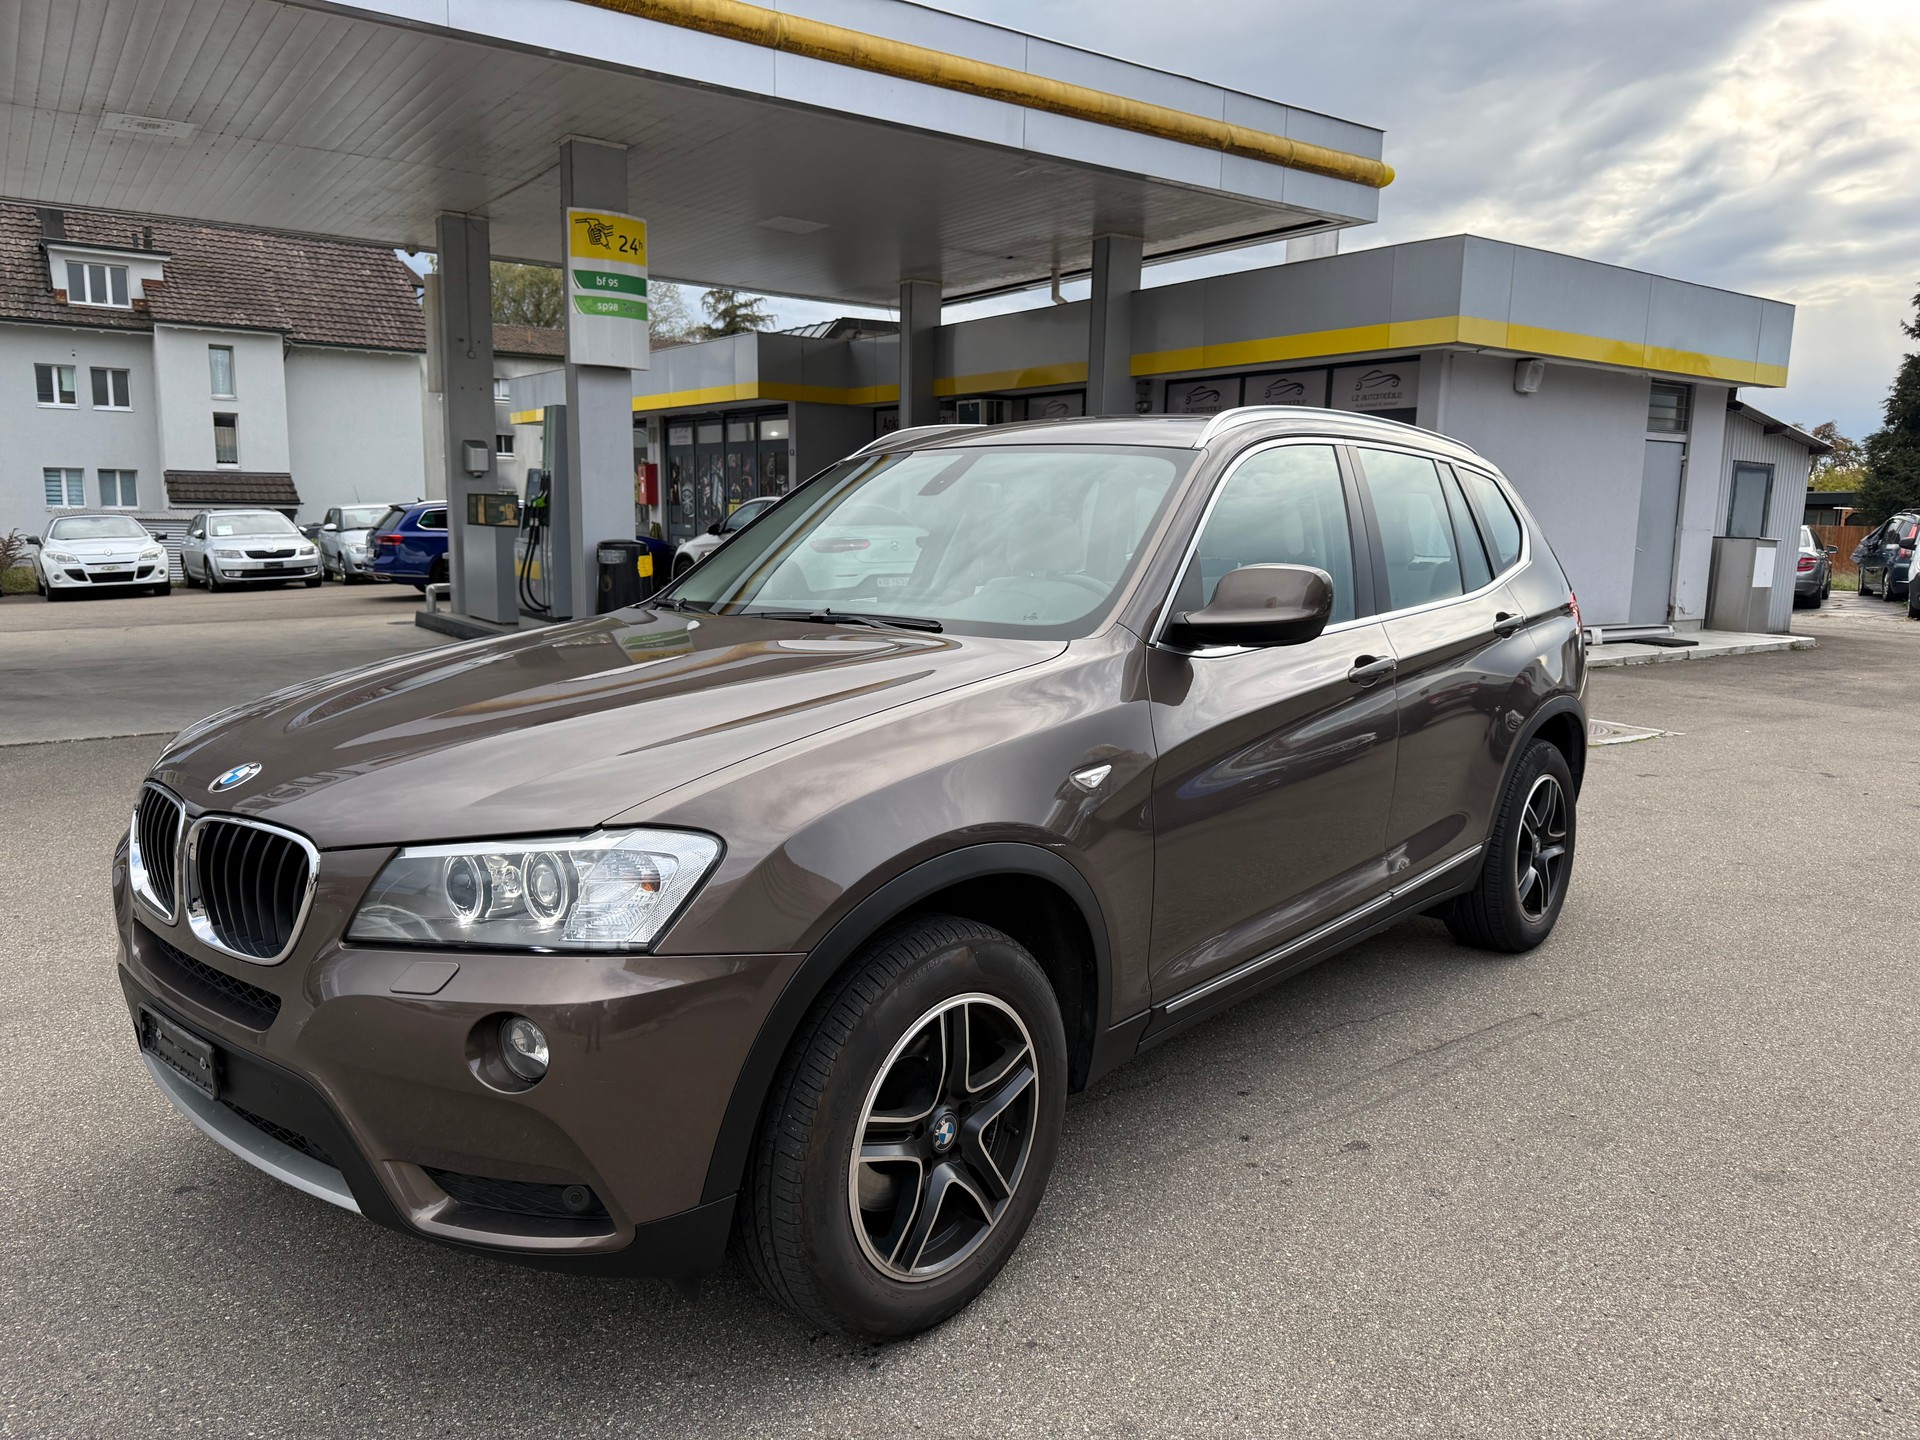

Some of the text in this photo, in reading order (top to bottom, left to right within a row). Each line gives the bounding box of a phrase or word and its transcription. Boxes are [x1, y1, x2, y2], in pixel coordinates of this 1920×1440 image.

[596, 276, 619, 288] bf 95
[597, 302, 619, 313] sp98
